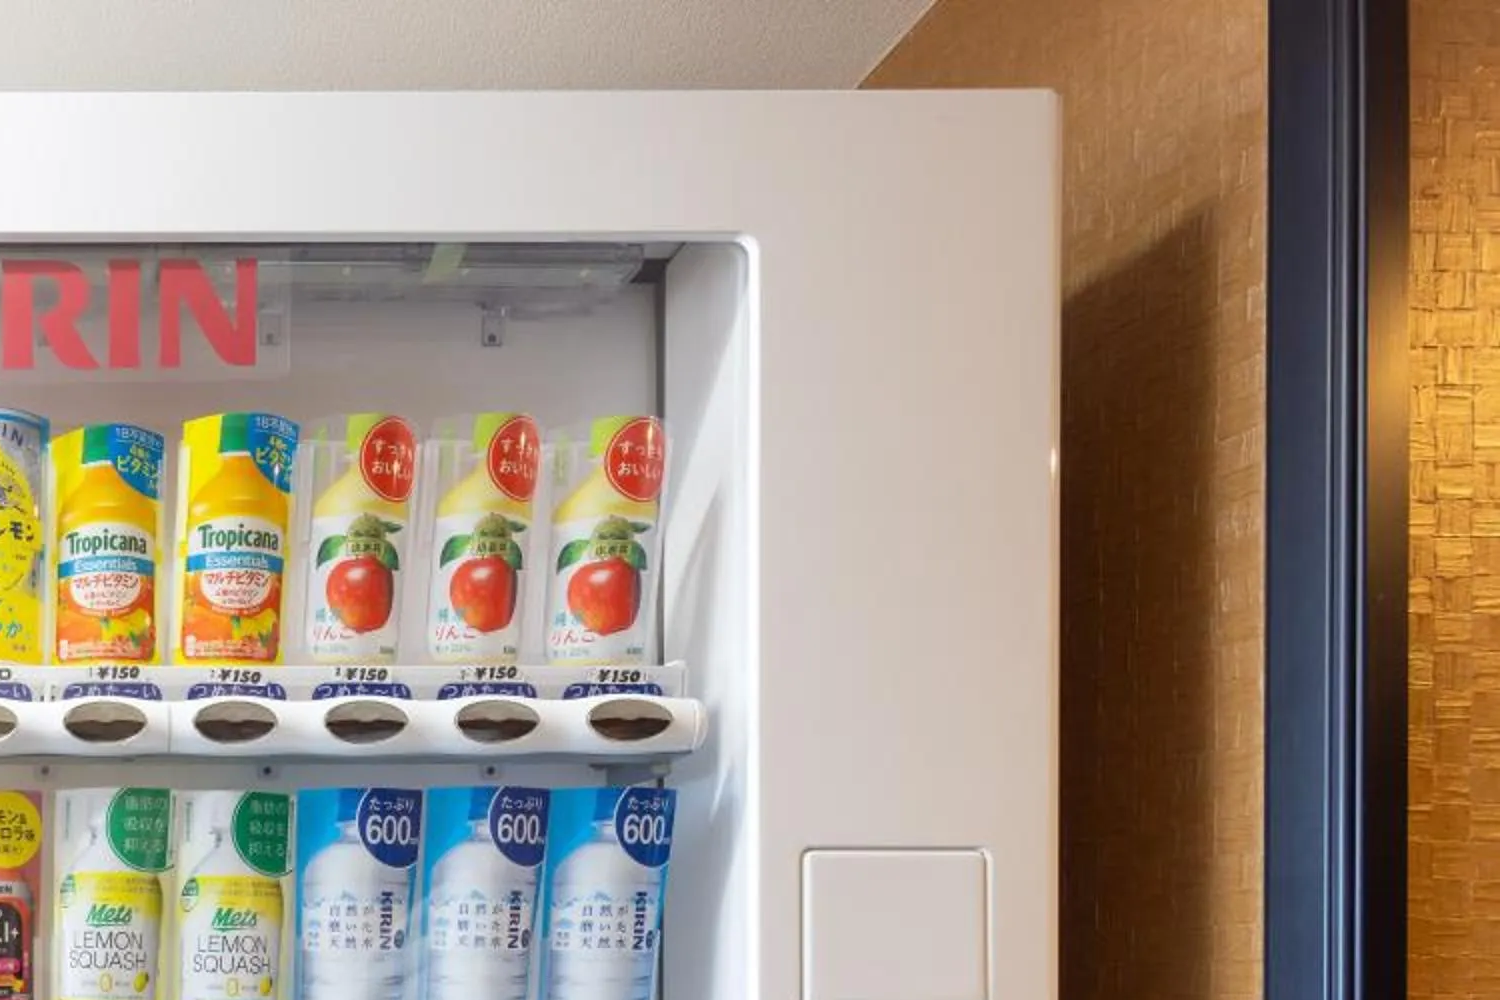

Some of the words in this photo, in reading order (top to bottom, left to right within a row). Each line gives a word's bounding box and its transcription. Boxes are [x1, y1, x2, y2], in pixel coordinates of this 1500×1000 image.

[66, 528, 147, 556] Tropicana
[198, 522, 279, 551] Tropicana
[97, 667, 140, 680] ¥150
[218, 669, 262, 683] ¥150
[347, 667, 388, 681] ¥150
[476, 666, 517, 680] ¥150
[599, 670, 640, 683] ¥150
[368, 798, 415, 812] たっぷり
[501, 796, 543, 810] たっぷり
[627, 797, 673, 810] たっぷり
[86, 904, 134, 927] Mets
[212, 907, 258, 931] Mets
[379, 891, 394, 950] KIRIN
[507, 890, 521, 950] KIRIN
[633, 891, 648, 951] KIRIN
[73, 931, 143, 950] LEMON
[198, 935, 267, 954] LEMON
[69, 951, 147, 971] SQUASH
[193, 956, 271, 974] SQUASH
